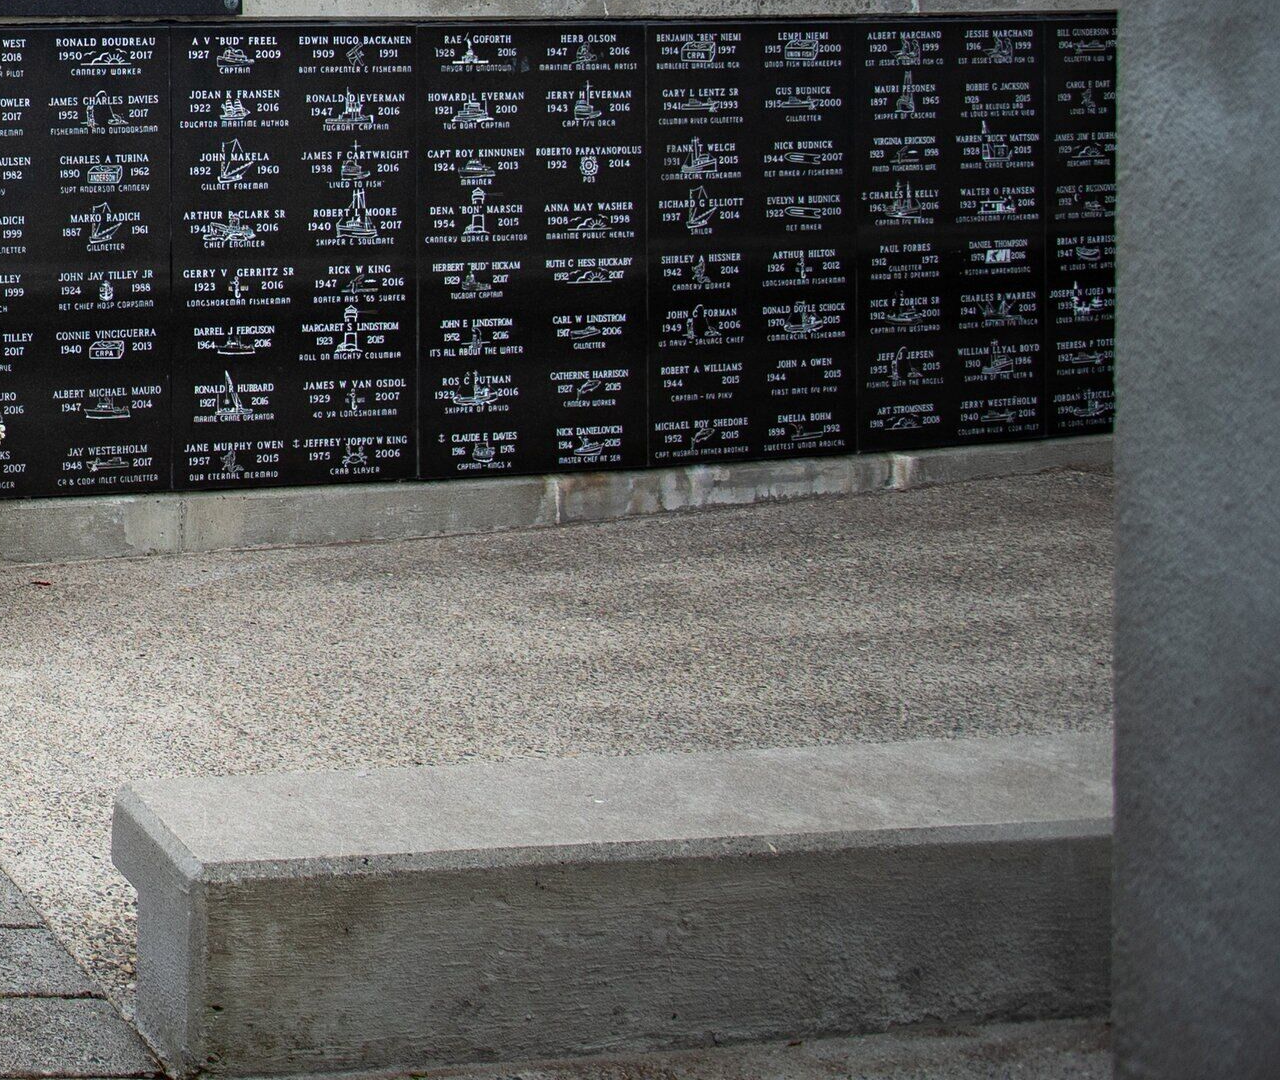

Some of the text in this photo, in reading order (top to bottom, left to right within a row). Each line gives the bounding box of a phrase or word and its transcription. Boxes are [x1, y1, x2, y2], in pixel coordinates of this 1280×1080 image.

[656, 33, 694, 42] BENJAMIN
[721, 33, 741, 41] NIEMI
[965, 29, 1033, 38] JESSIE MARCHAND
[56, 38, 155, 46] RONALD BOUDREAU
[249, 37, 277, 45] FREEL
[333, 36, 359, 45] HUGO
[363, 35, 412, 45] BACKANEN
[189, 50, 281, 59] 1927 2009
[313, 49, 397, 58] 1909 1991
[662, 46, 736, 55] 1914 1997
[59, 51, 152, 60] 1950 2017
[686, 51, 706, 60] CRPA
[776, 87, 791, 95] GUS
[2, 112, 21, 120] 2017
[774, 141, 832, 150] NICK BUDNICK
[428, 149, 524, 158] CAPT ROY KINNUNEN
[764, 153, 843, 163] 1944 2007
[434, 162, 518, 171] 1924 2013
[960, 188, 990, 196] WALTER
[993, 187, 999, 195] O
[544, 202, 633, 212] ANNA MAY WASHER
[548, 215, 630, 225] 1908 1998
[5, 288, 24, 296] 1999
[56, 329, 156, 340] CONNIE VINCIGUERRA
[61, 342, 152, 354] 1940 2013
[95, 349, 114, 358] CRPA
[777, 360, 797, 368] JOHN
[811, 358, 832, 366] OWEN
[824, 370, 841, 378] 2015
[303, 381, 334, 390] JAMES
[352, 380, 371, 390] VAN
[376, 379, 406, 387] OSDOL
[310, 392, 399, 403] 1929 2007
